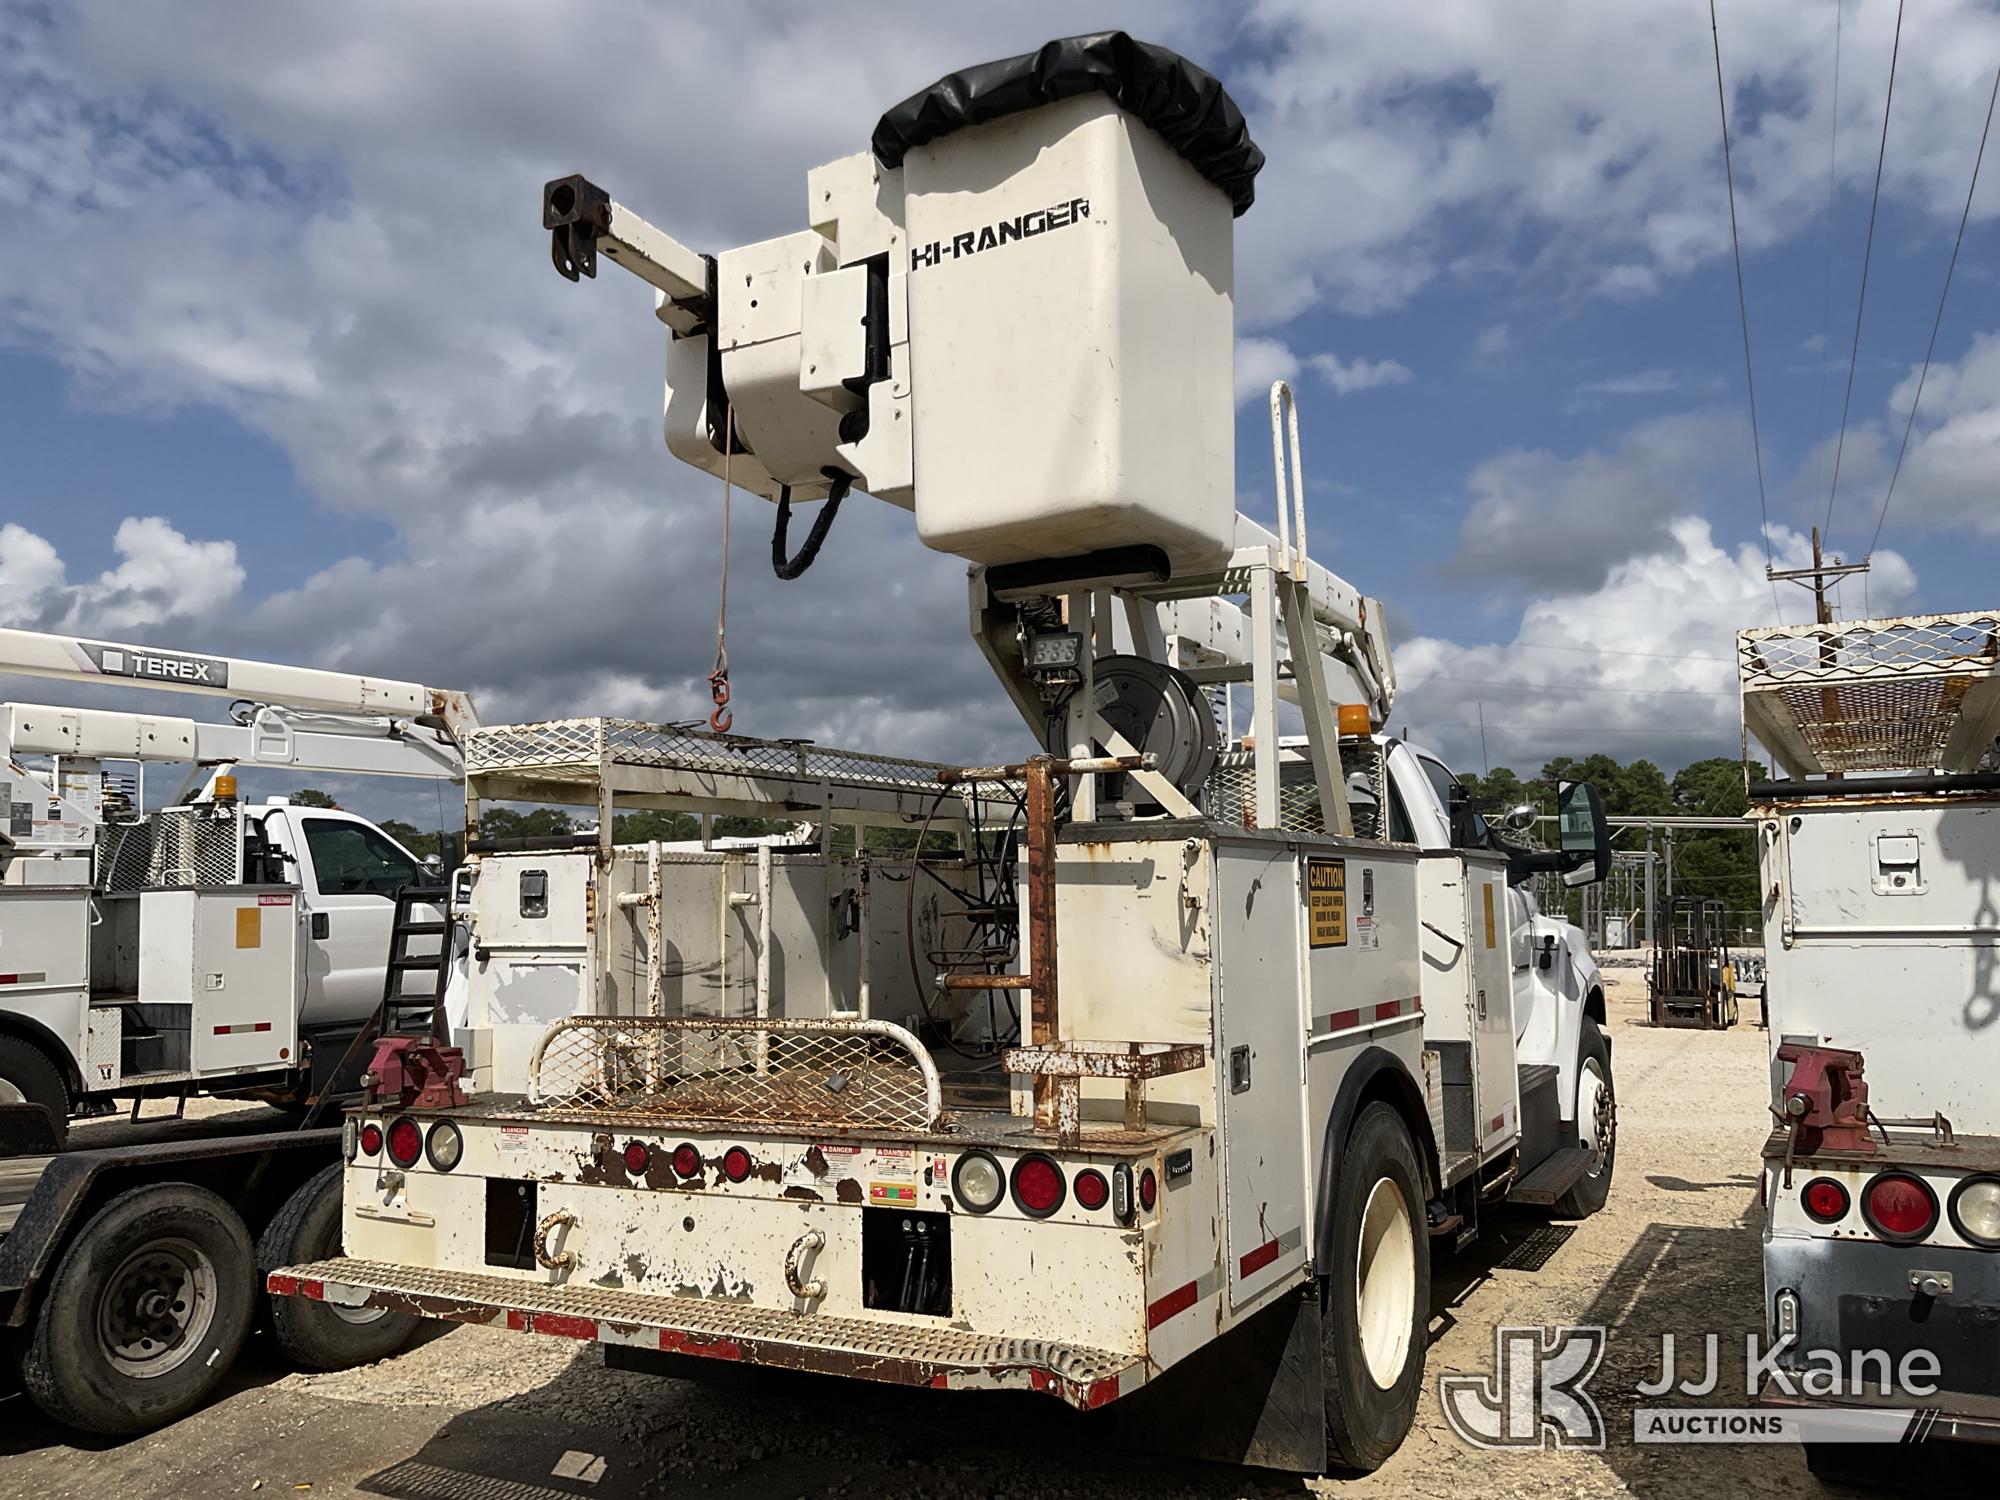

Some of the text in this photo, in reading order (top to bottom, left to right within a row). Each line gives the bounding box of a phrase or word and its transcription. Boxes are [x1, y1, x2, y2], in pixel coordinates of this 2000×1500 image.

[911, 197, 1090, 272] HI-RANGER
[131, 655, 210, 681] TEREX
[1310, 866, 1344, 887] CAUTION
[1321, 896, 1333, 906] CLEAR
[883, 1149, 911, 1157] DANGER
